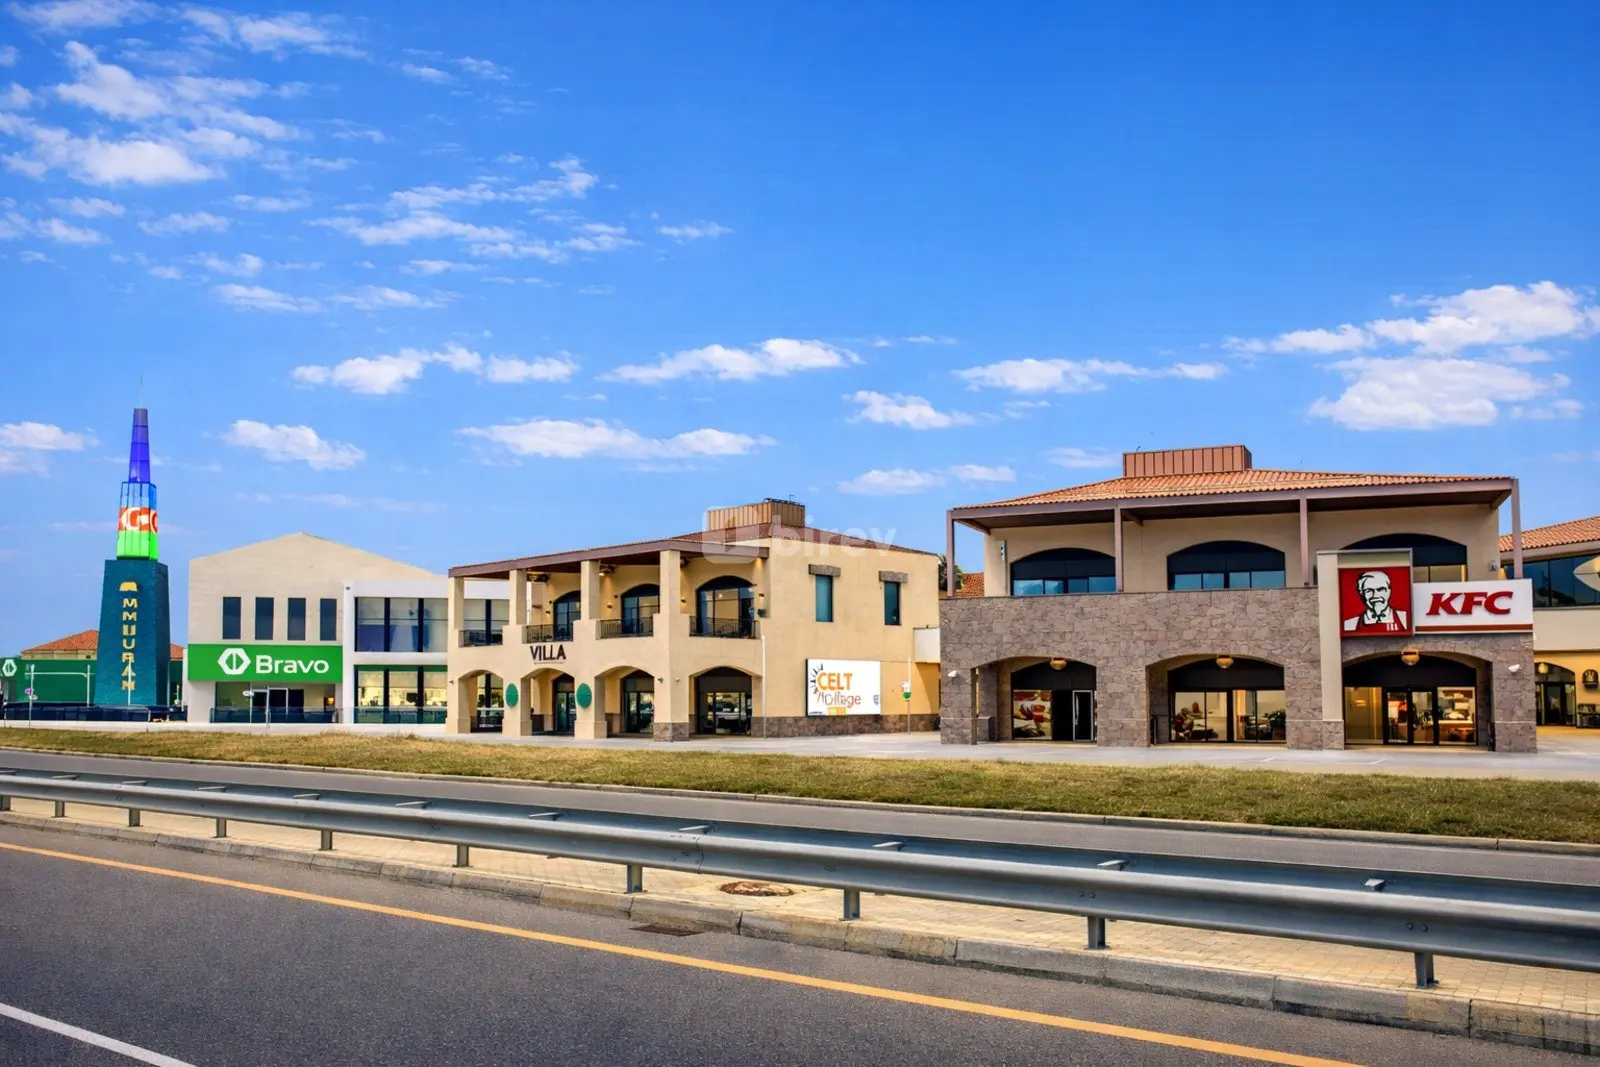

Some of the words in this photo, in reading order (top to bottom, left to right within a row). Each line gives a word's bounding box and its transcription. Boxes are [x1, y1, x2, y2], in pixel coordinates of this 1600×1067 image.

[1425, 591, 1514, 616] KFC
[529, 644, 567, 661] VILLA
[255, 654, 330, 675] Bravo
[817, 671, 853, 691] CELT
